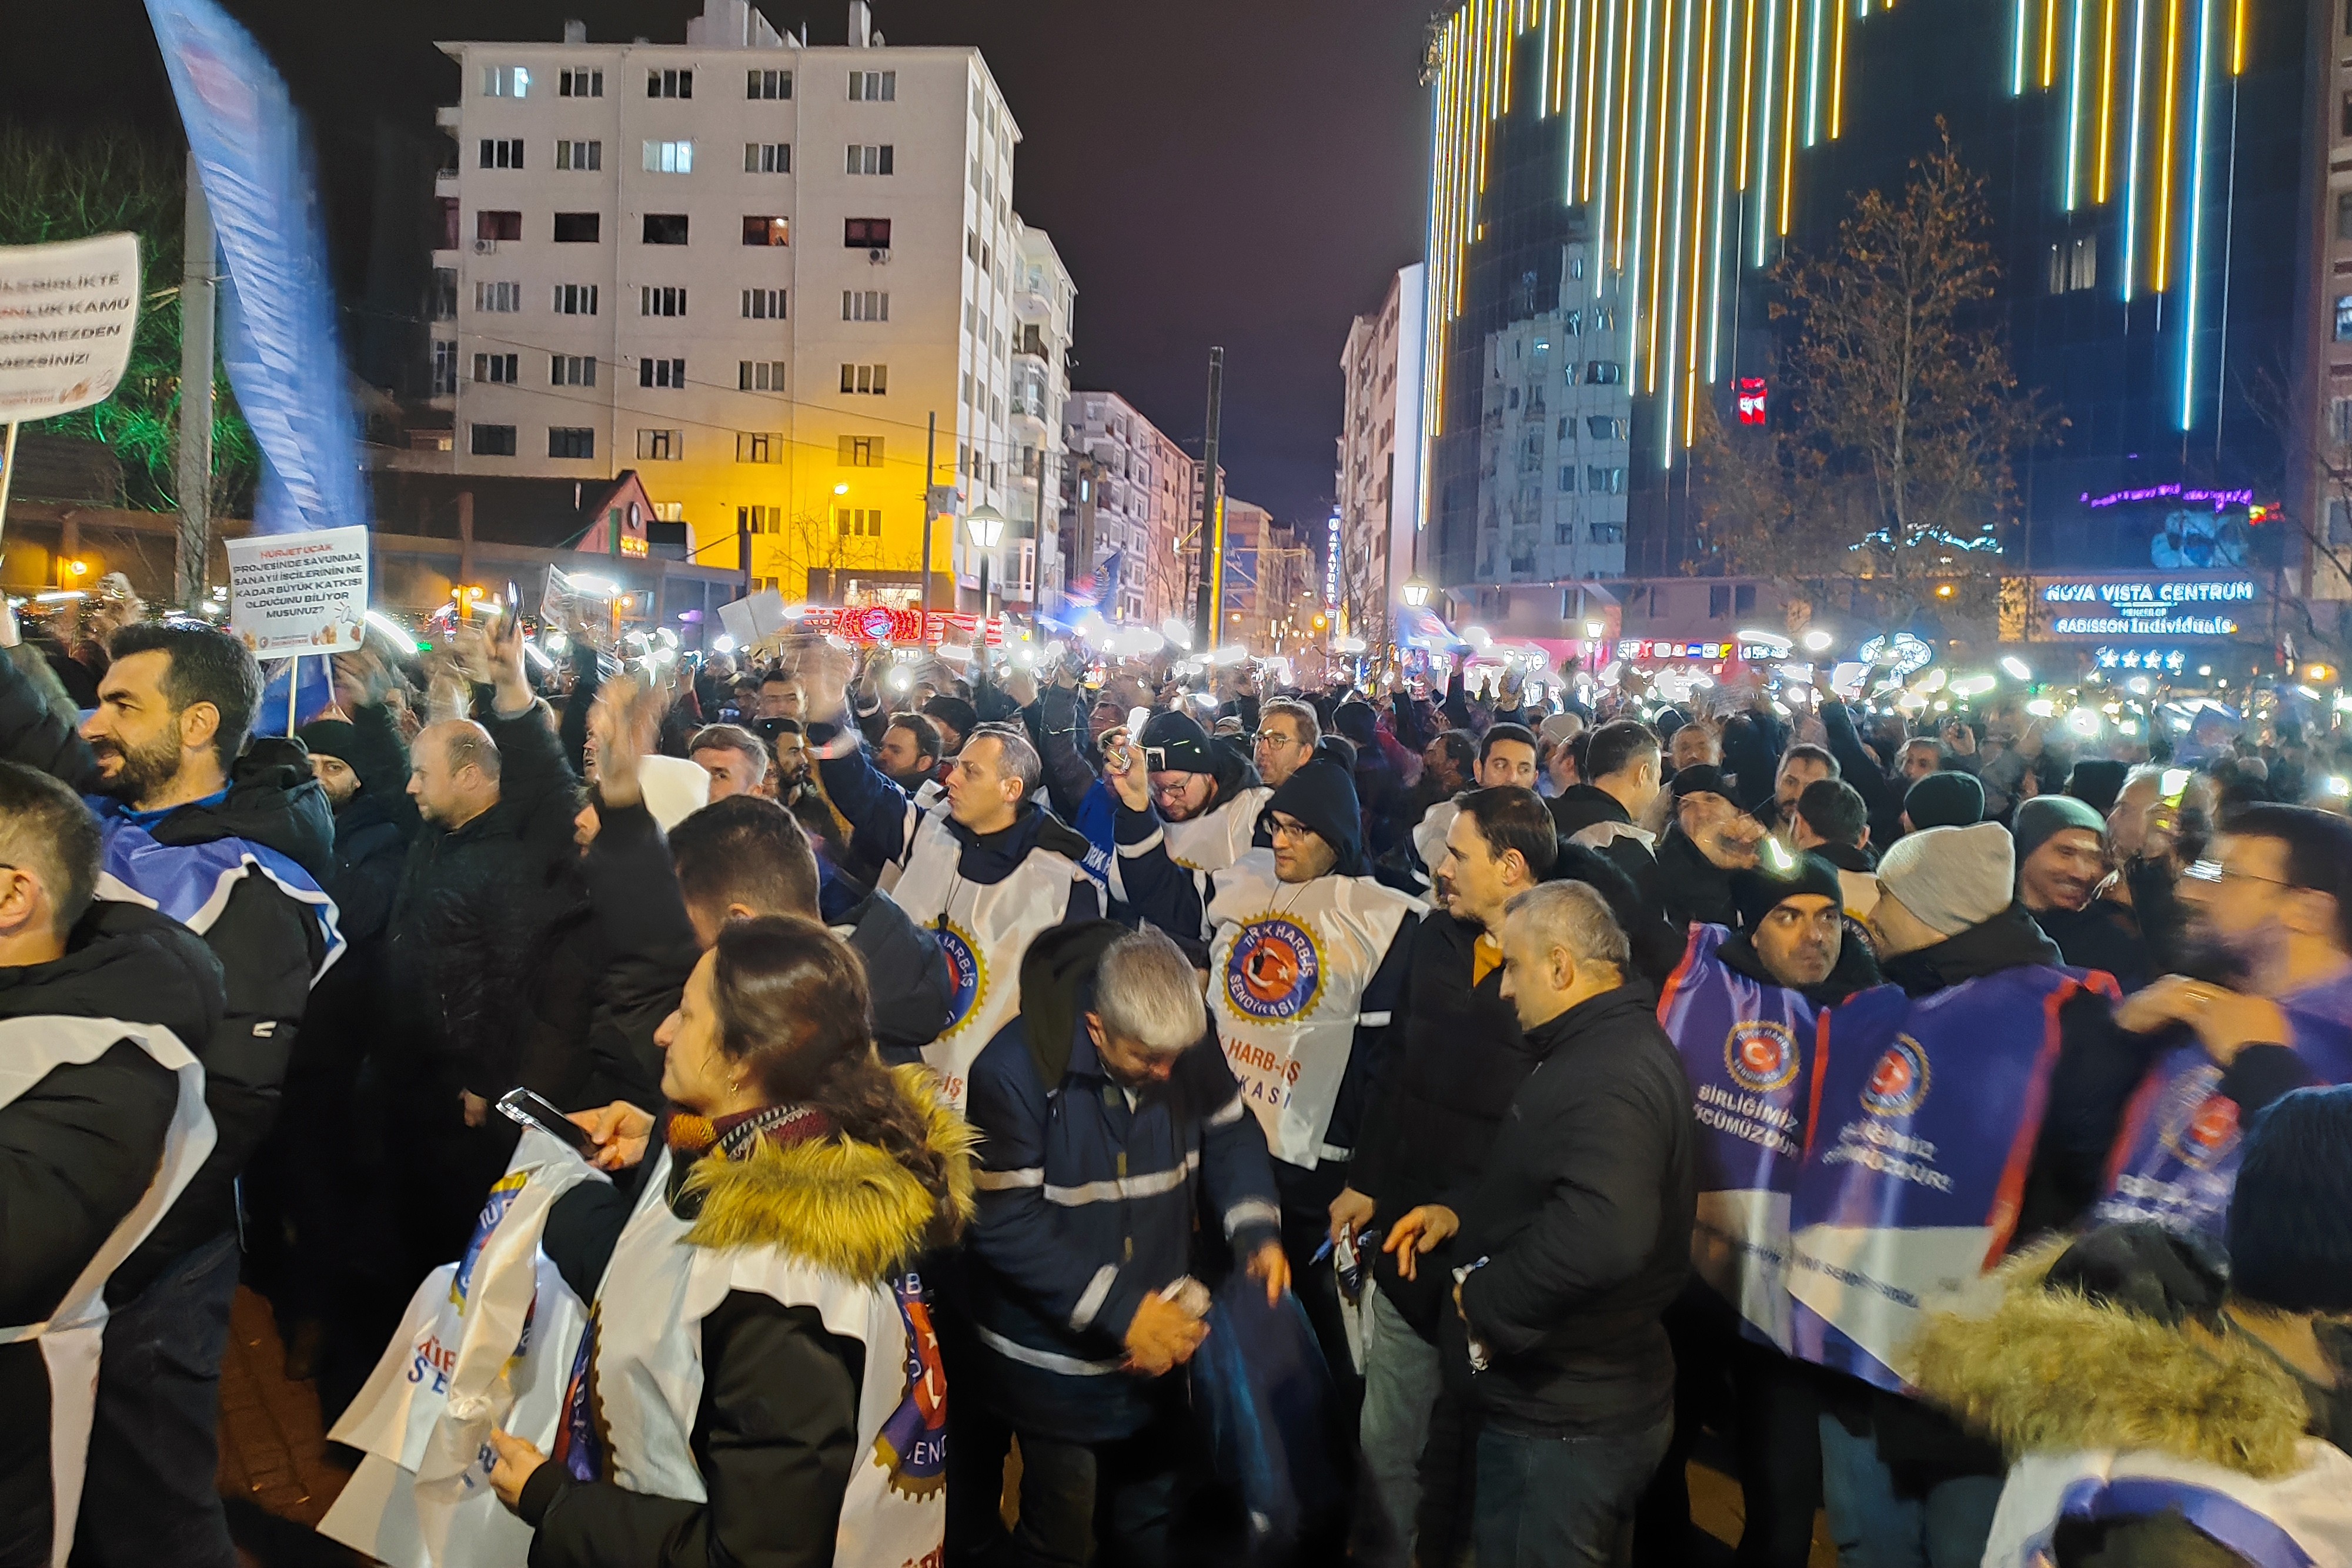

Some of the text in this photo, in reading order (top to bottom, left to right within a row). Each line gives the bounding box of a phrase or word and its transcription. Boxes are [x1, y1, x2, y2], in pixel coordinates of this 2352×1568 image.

[67, 296, 131, 315] KAMU
[233, 553, 362, 574] PROJESİNDE SAVUNMA
[346, 564, 363, 574] NE
[1326, 531, 1338, 604] ATAYURT
[235, 586, 275, 598] KADAR
[315, 577, 363, 591] KATKISI
[305, 590, 349, 604] BİLİYOR
[2046, 580, 2253, 601] NOVA VISTA CENTRUM
[266, 605, 325, 618] MUSUNUZ?
[2056, 616, 2233, 634] RADISSON Individuals
[1698, 1083, 1798, 1133] BİRLİĞİMİZ
